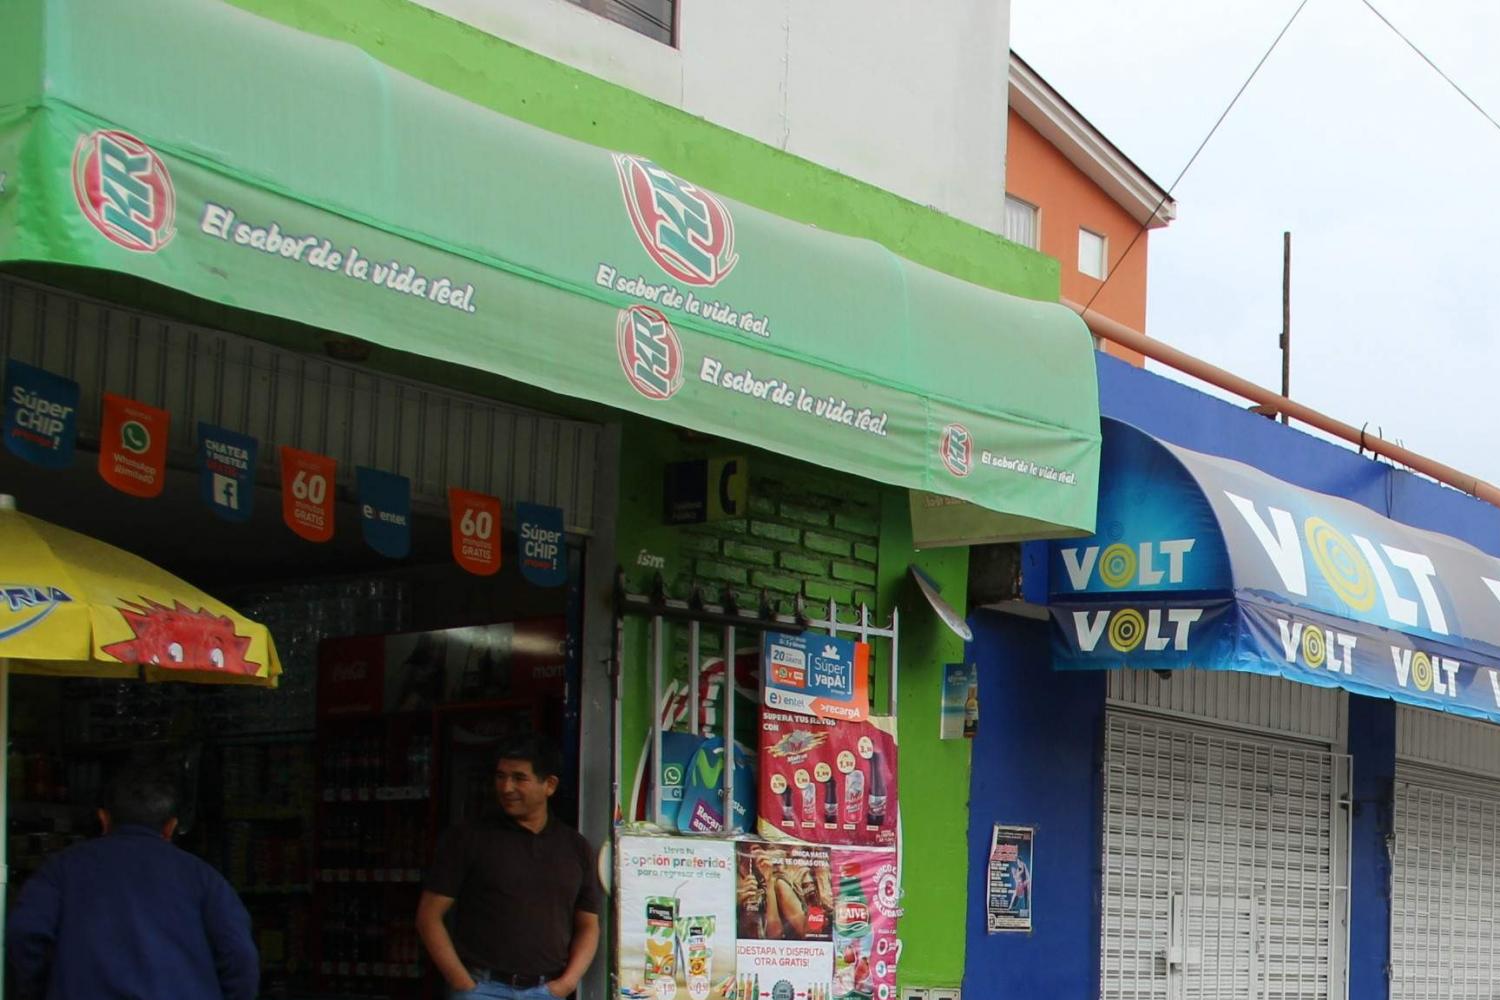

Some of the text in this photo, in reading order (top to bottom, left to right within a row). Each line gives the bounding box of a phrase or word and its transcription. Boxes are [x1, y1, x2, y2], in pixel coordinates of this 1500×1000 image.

[202, 203, 477, 313] El sabor de la vida real.
[596, 263, 771, 338] El sabor de la vida real.
[12, 385, 75, 419] Súper
[700, 357, 888, 436] El sabor de la vida real.
[15, 408, 65, 437] CHIP
[205, 439, 249, 461] CHATEA
[981, 451, 991, 465] El
[992, 456, 1018, 470] sabor
[1017, 461, 1029, 474] de
[1038, 466, 1058, 481] vida
[292, 470, 327, 505] 60
[294, 508, 326, 527] GRATIS
[380, 510, 407, 527] entel
[460, 508, 494, 540] 60
[520, 522, 561, 545] Súper
[462, 545, 492, 561] GRATIS
[524, 541, 559, 560] CHIP
[1060, 538, 1196, 591] VOLT
[1223, 490, 1449, 636] VOLT
[1072, 608, 1204, 652] VOLT
[773, 649, 785, 662] 20
[814, 657, 846, 676] Súper
[1276, 618, 1357, 676] VOLT
[1390, 645, 1461, 698] VOLT
[815, 673, 846, 689] yapA!
[763, 712, 793, 722] SUPERA
[795, 715, 809, 724] TUS
[763, 723, 779, 732] CON
[632, 854, 726, 869] opción preferida
[637, 868, 658, 877] para
[754, 957, 810, 968] OTRA GRATIS!
[779, 947, 785, 956] Y
[786, 947, 825, 957] DISFRUTA
